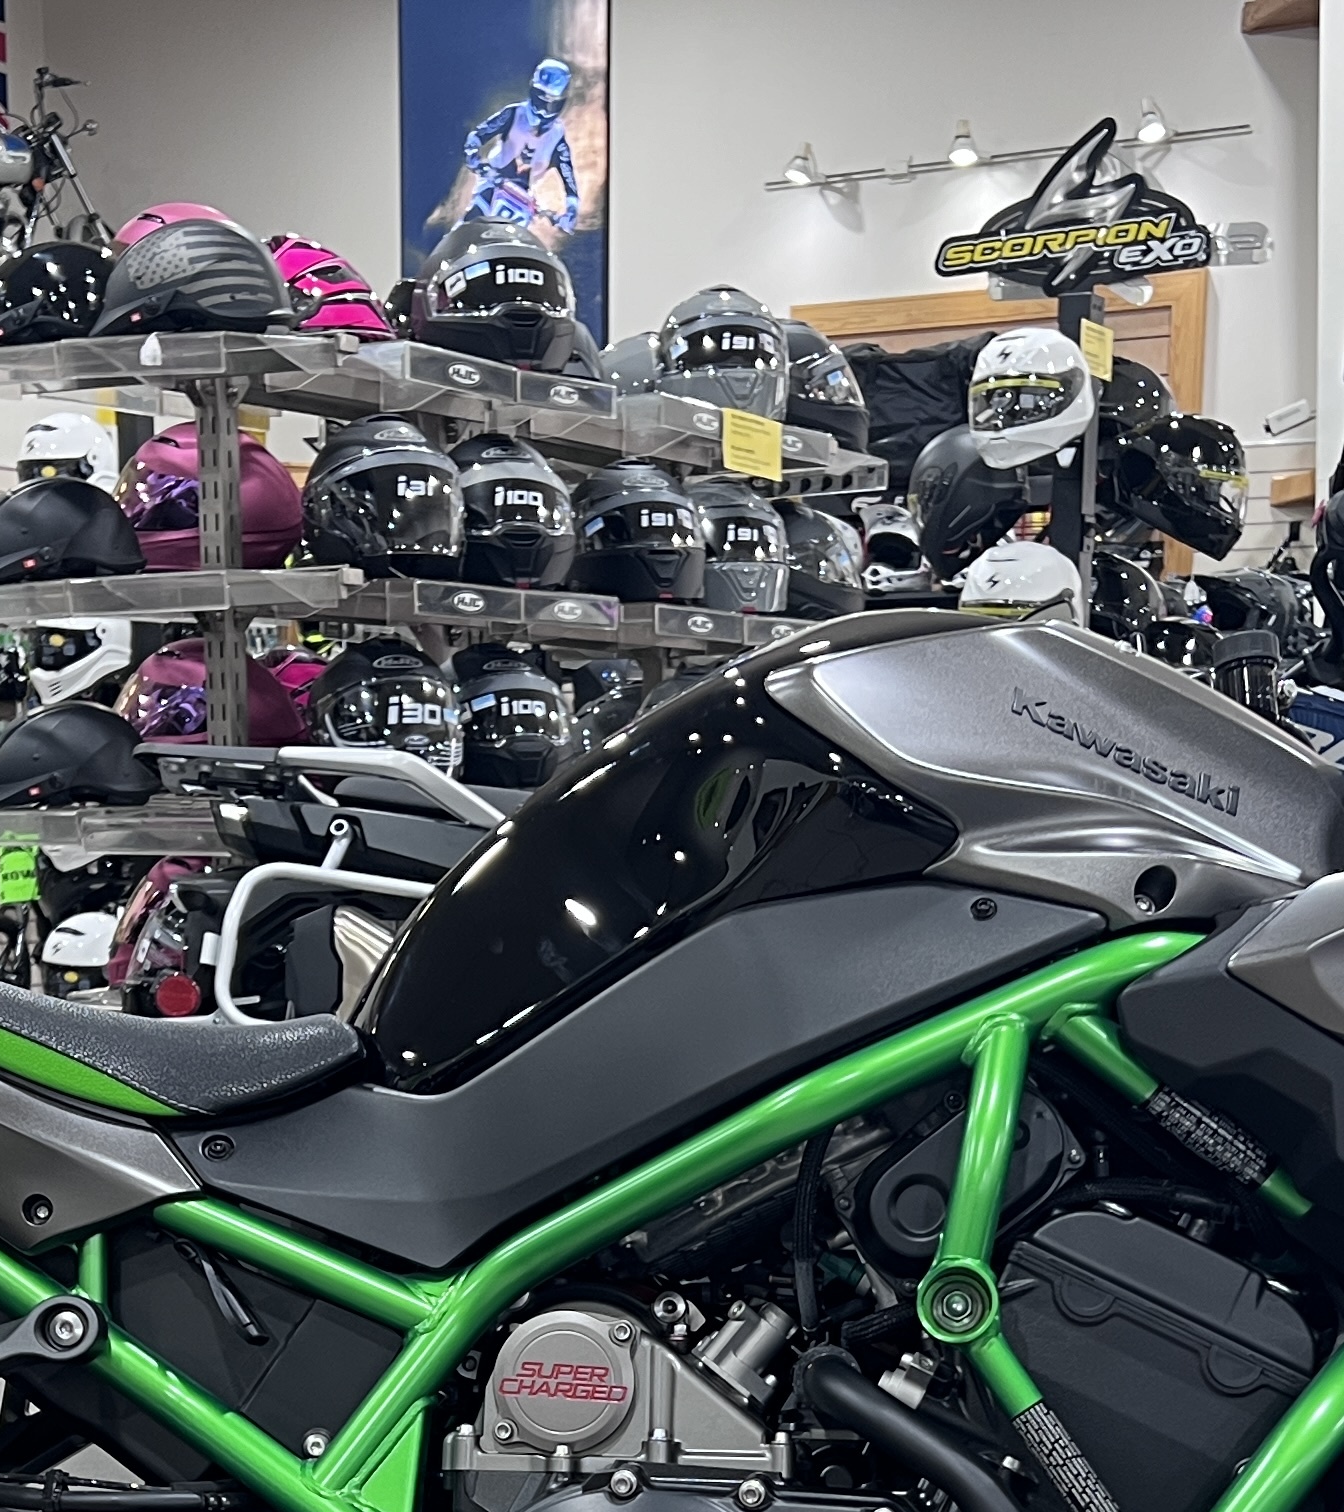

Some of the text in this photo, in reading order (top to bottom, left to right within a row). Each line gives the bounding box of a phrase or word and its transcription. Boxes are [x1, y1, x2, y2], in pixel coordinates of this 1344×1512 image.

[943, 217, 1205, 268] SCORPION EXO
[495, 264, 544, 286] i100
[494, 486, 544, 507] i100
[387, 695, 442, 726] i30
[1010, 687, 1241, 817] Kawasaki
[516, 1361, 610, 1383] SUPER
[498, 1377, 628, 1402] CHARGED
